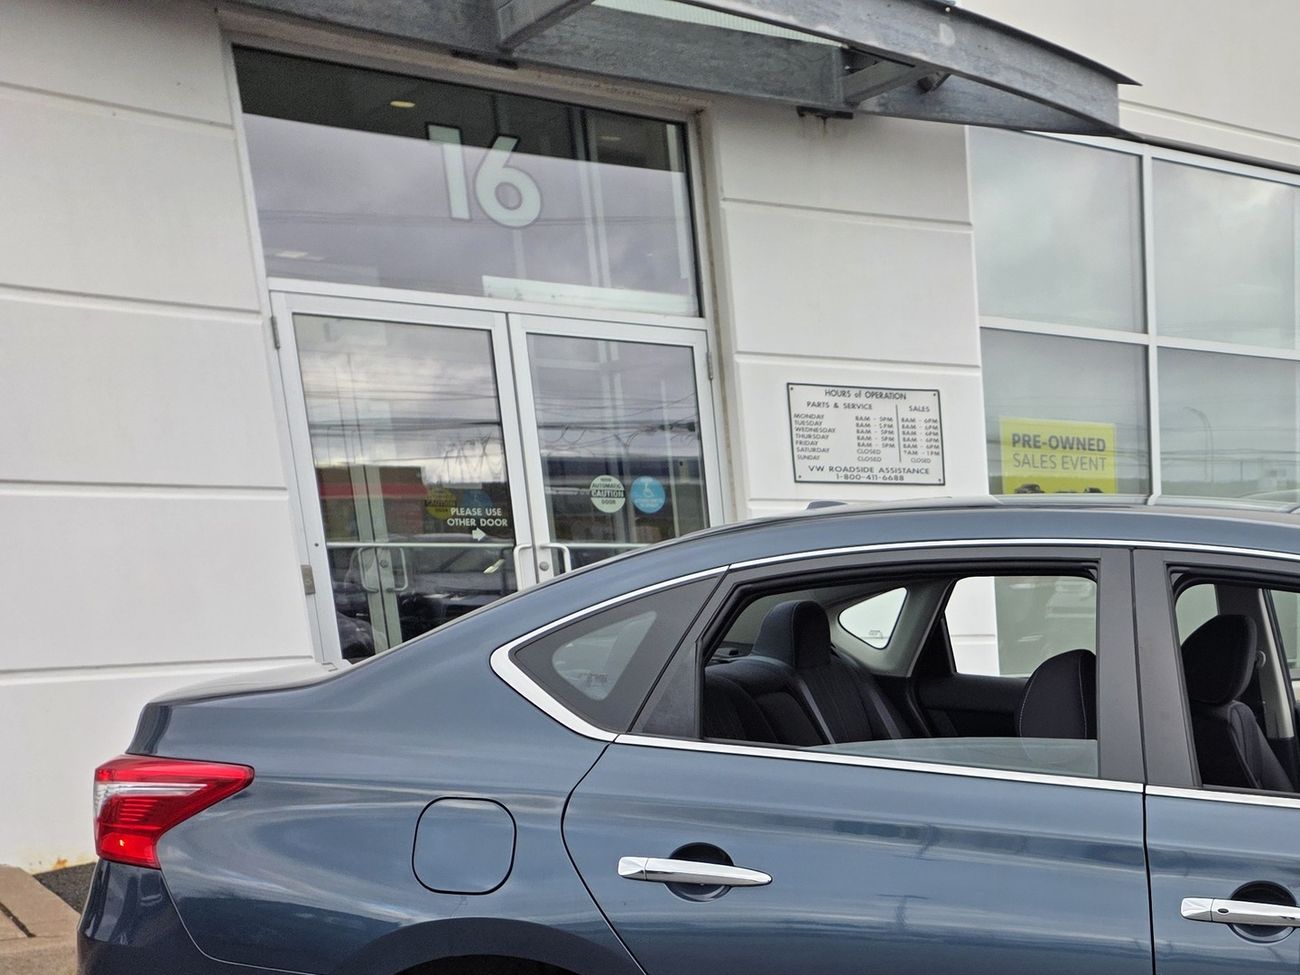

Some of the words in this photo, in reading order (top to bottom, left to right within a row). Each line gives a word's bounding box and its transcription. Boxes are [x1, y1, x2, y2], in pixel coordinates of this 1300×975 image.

[426, 123, 543, 229] 16
[825, 389, 850, 398] HOURS
[865, 392, 906, 400] OPERATION
[1012, 433, 1106, 452] PRE-OWNED
[1012, 453, 1057, 470] SALES
[1062, 455, 1106, 471] EVENT
[450, 508, 482, 516] PLEASE
[485, 508, 502, 516] USE
